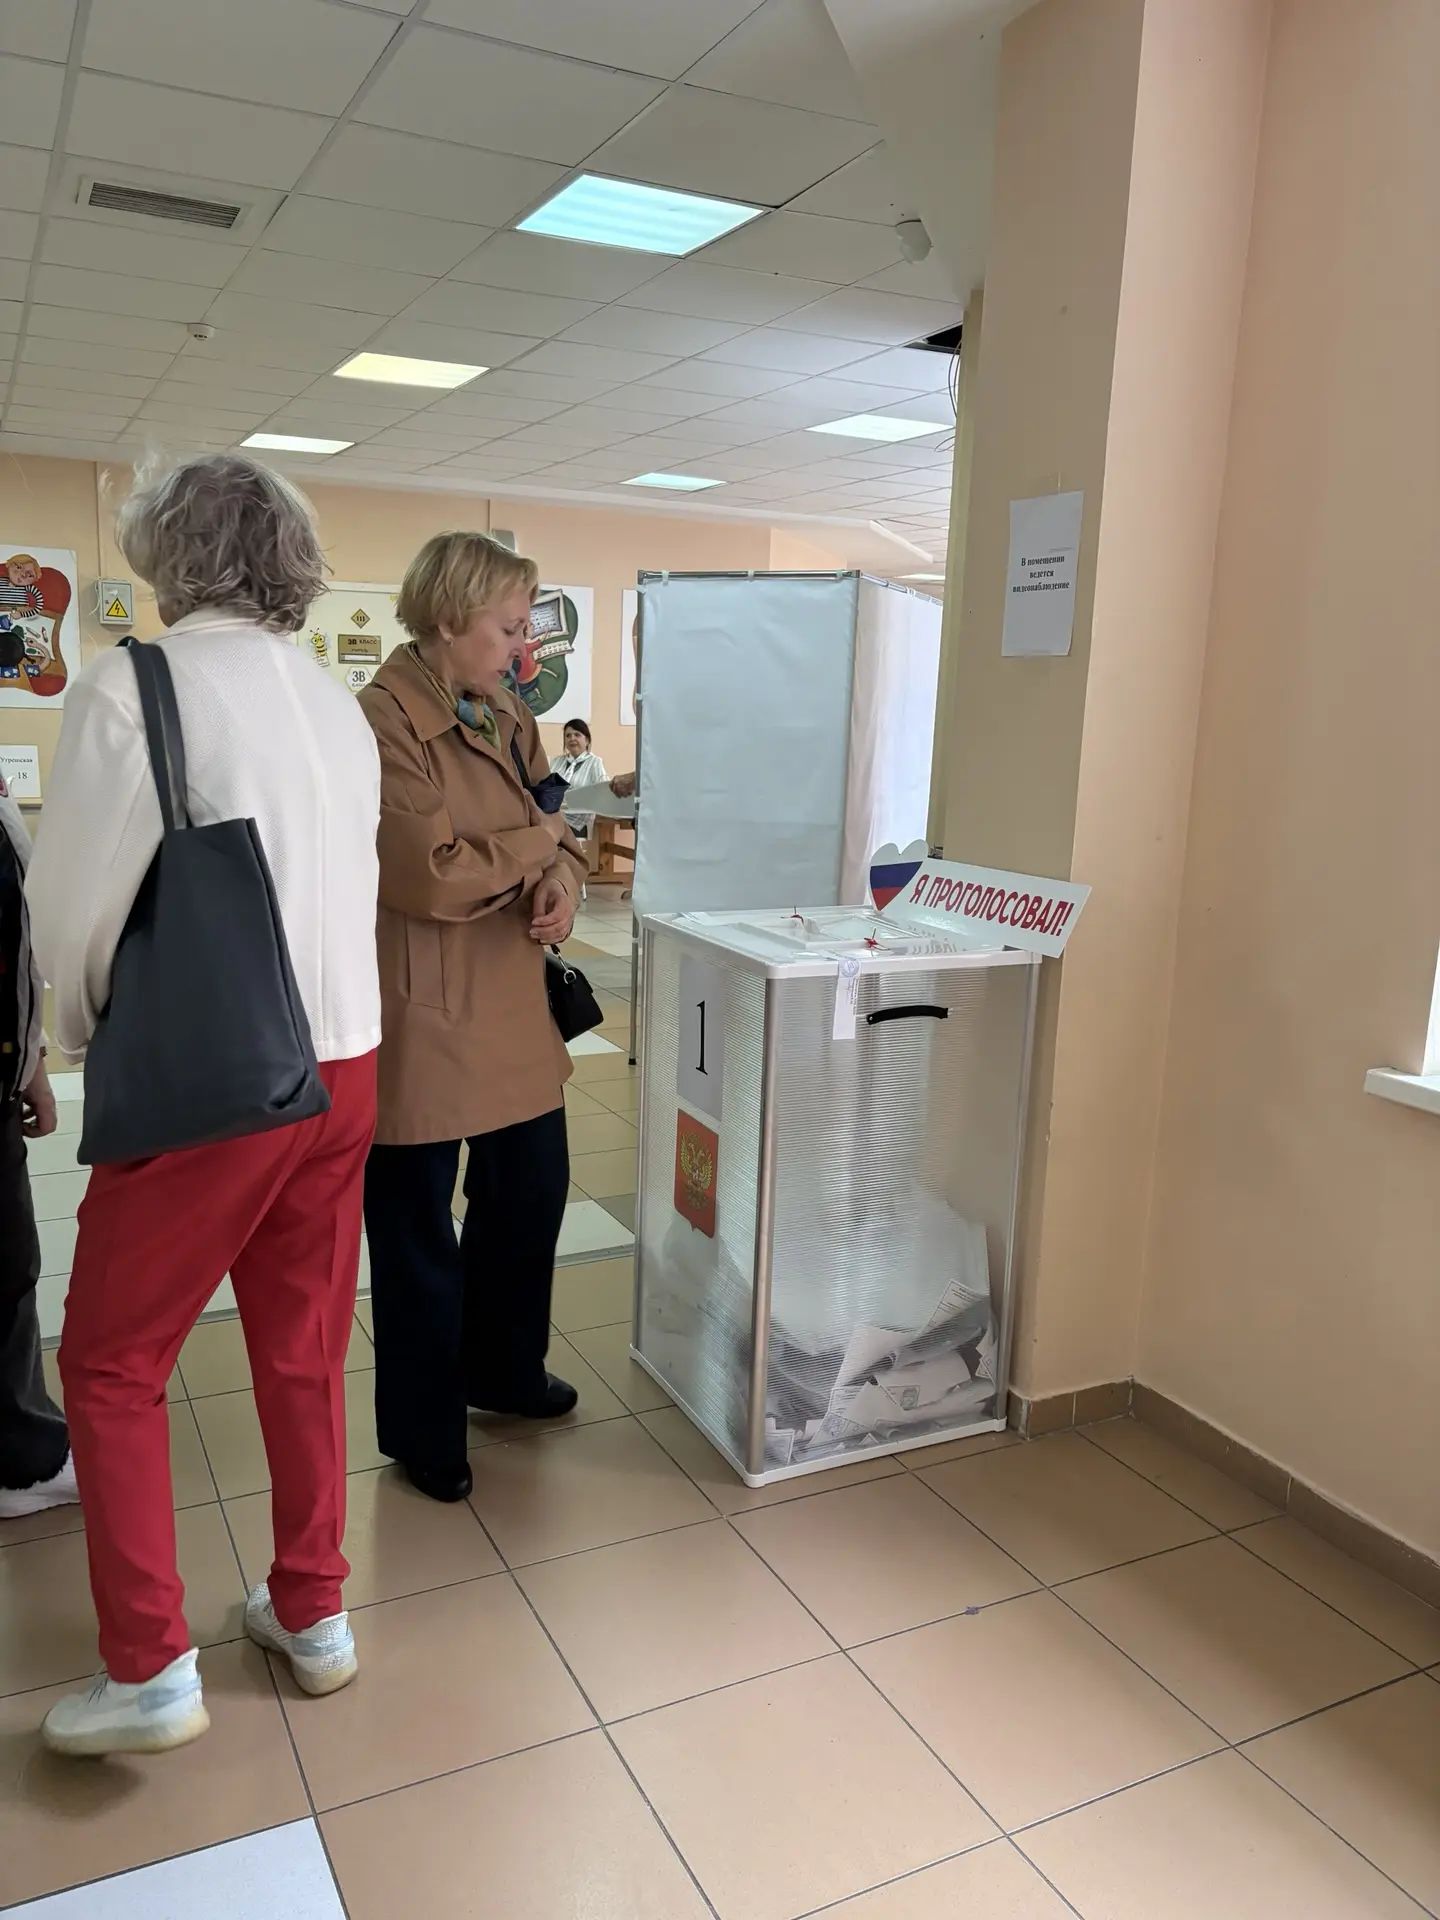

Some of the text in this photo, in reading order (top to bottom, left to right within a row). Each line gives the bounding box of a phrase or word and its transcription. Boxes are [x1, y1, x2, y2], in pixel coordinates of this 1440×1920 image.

[1020, 555, 1065, 567] В помещении
[1012, 581, 1070, 593] видеонаблюдение
[351, 670, 366, 683] 3В
[17, 771, 28, 780] 18
[909, 874, 1075, 937] Я ПРОГОЛОСОВАЛ!
[695, 1000, 709, 1076] 1
